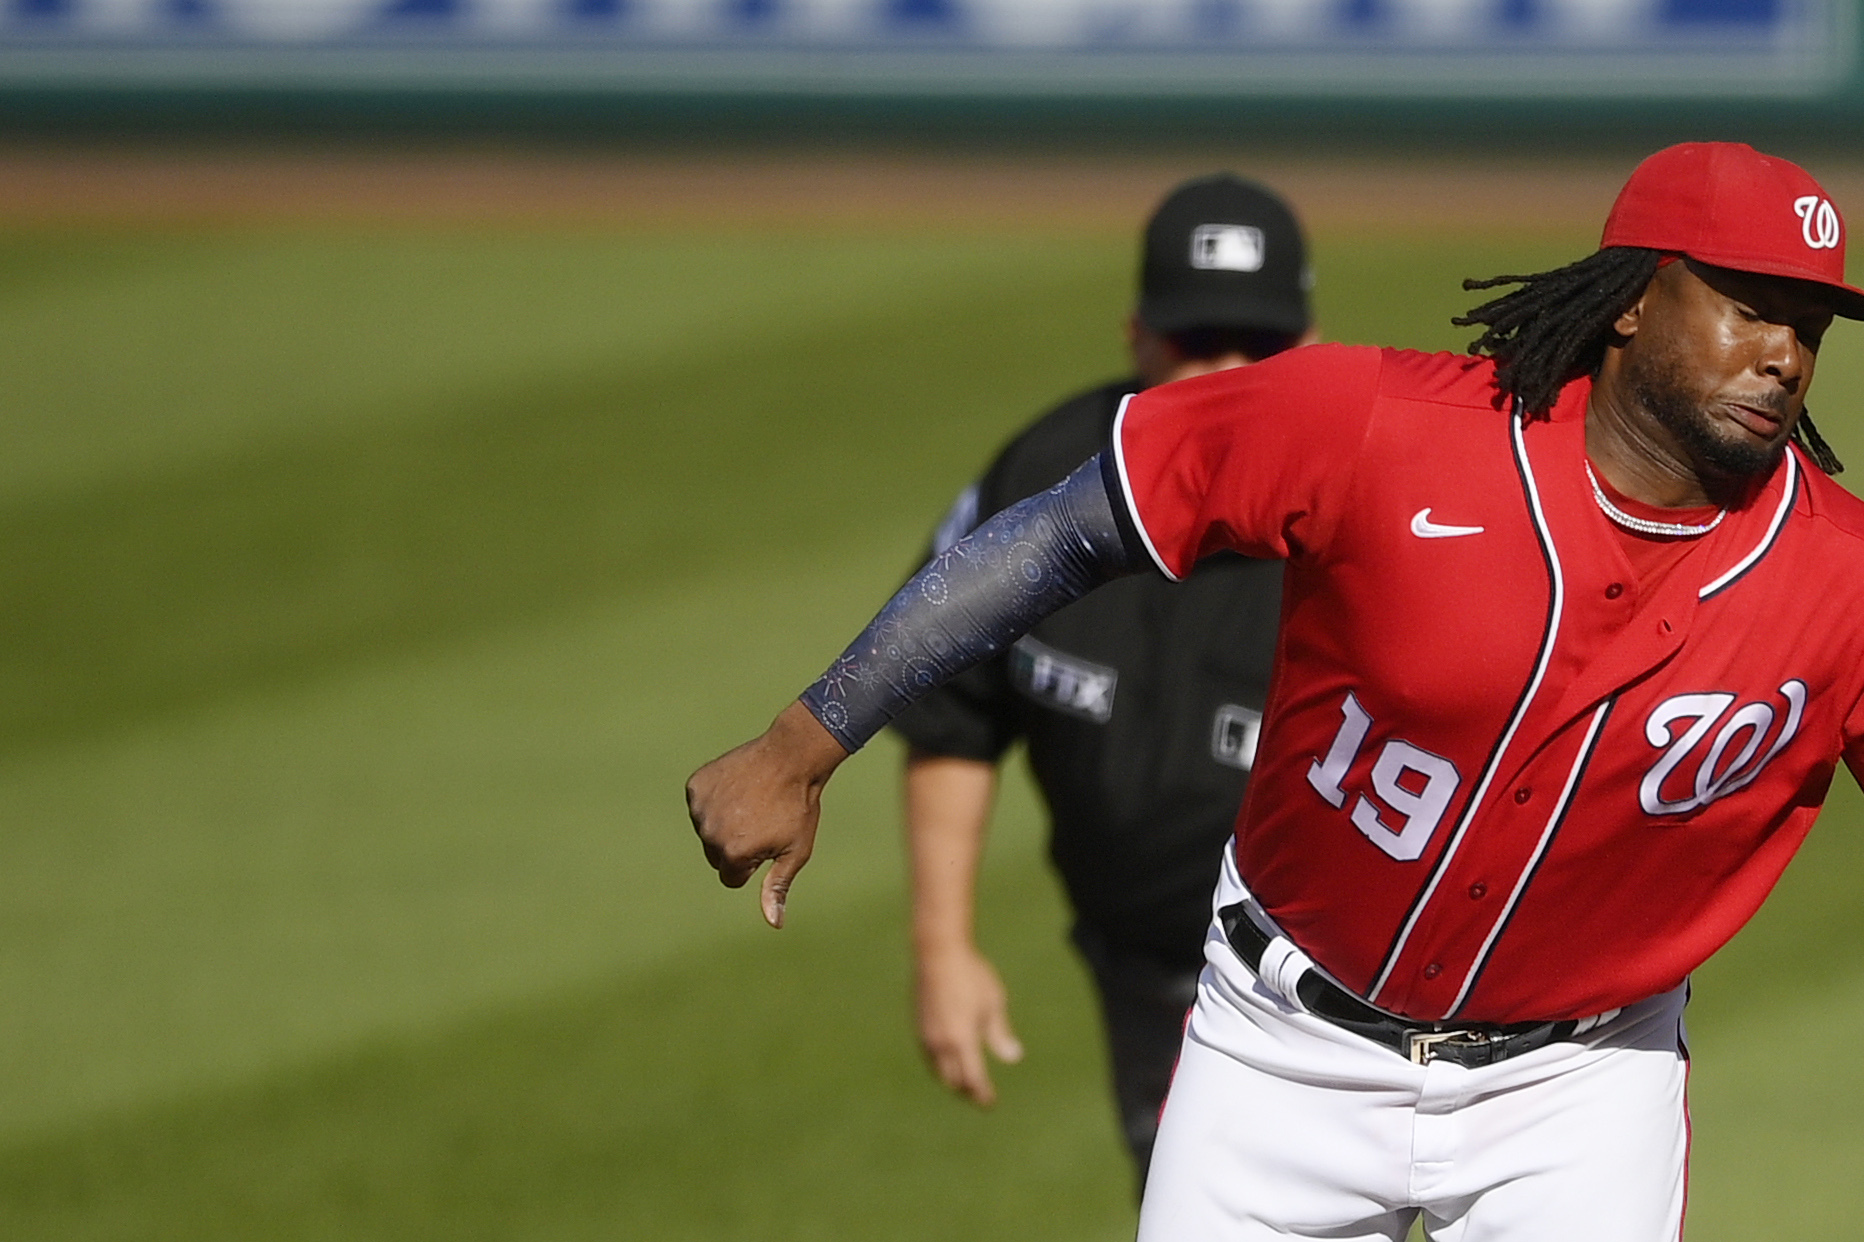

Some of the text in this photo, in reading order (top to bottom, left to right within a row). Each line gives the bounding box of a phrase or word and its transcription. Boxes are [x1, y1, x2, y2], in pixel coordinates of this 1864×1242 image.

[1793, 195, 1840, 249] W
[1306, 690, 1462, 862] 19
[1638, 677, 1809, 816] W
